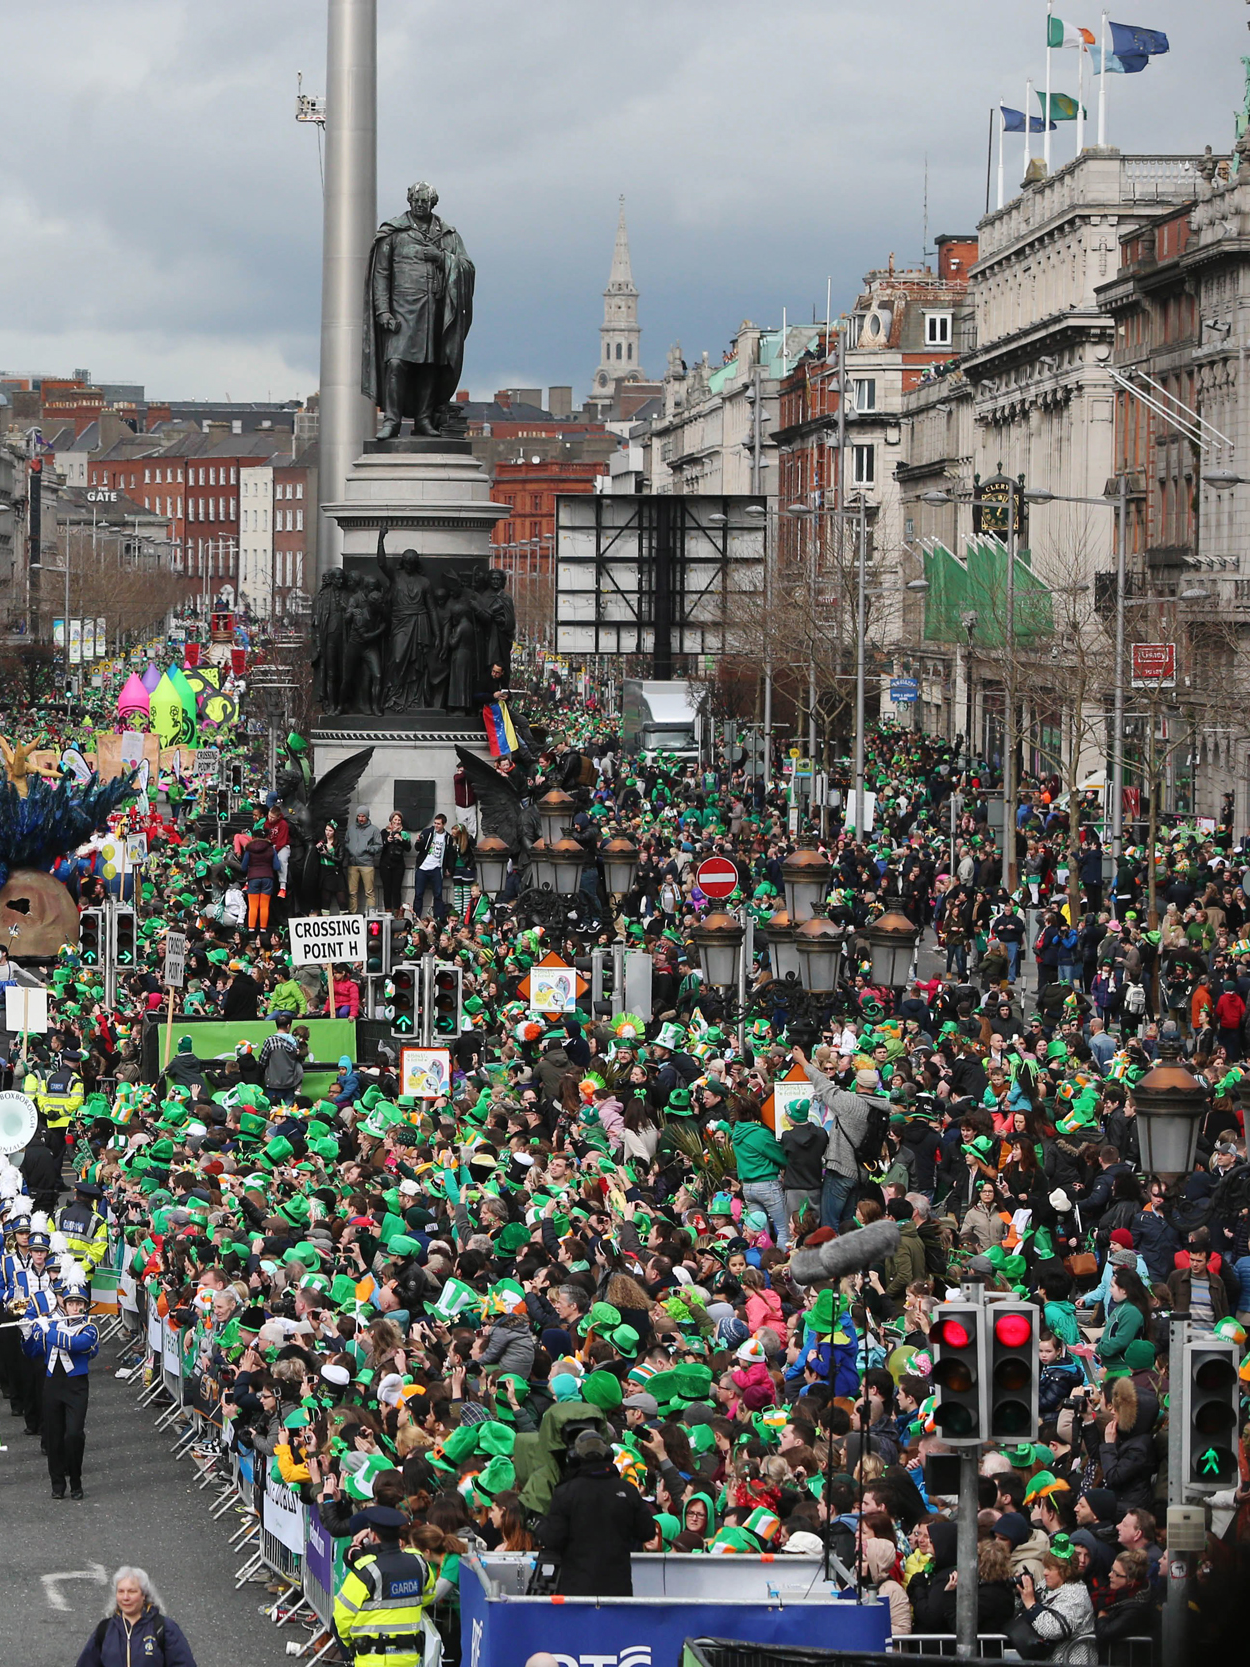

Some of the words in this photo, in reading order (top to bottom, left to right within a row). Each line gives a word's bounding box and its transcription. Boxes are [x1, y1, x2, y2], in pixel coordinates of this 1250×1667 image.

[87, 492, 117, 502] GATE
[197, 750, 218, 760] CROSSING
[295, 919, 361, 939] CROSSING
[303, 942, 344, 960] POINT
[349, 940, 358, 956] H
[391, 1581, 419, 1596] GARDA
